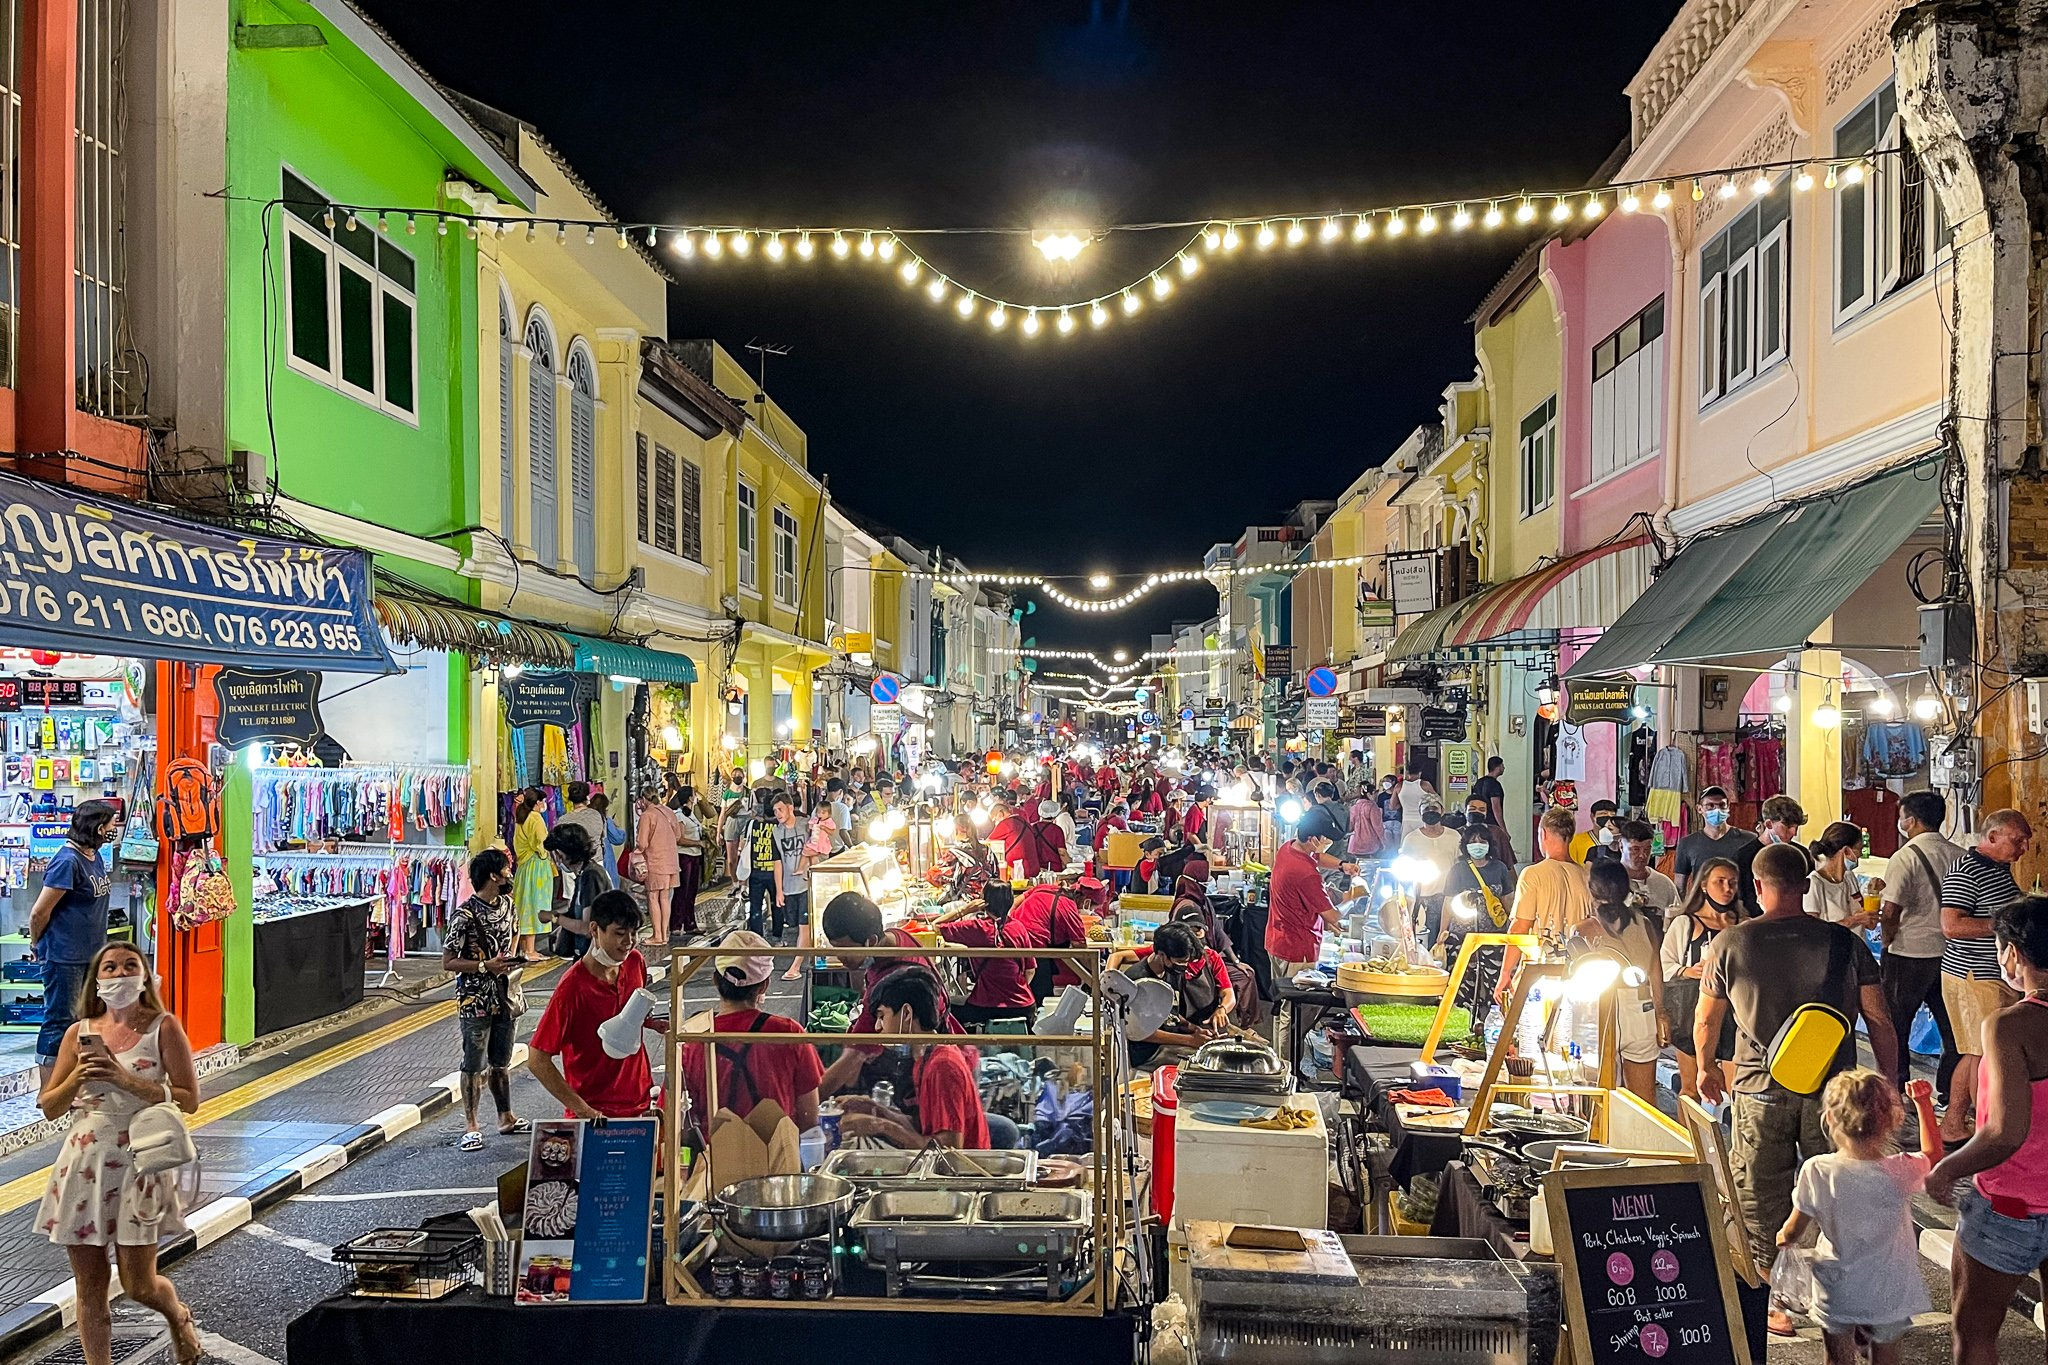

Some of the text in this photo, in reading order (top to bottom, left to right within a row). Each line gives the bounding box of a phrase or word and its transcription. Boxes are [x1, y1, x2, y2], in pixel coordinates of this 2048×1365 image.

[67, 591, 132, 632] 211
[214, 613, 266, 646] 076
[271, 619, 317, 649] 223
[319, 623, 362, 651] 955
[229, 702, 309, 713] BOONLERT ELECTRIC
[1583, 1232, 1607, 1249] Pork,
[1606, 1228, 1646, 1245] Chicken,
[1634, 1307, 1674, 1321] Best seller
[1610, 1325, 1640, 1352] Shrimp
